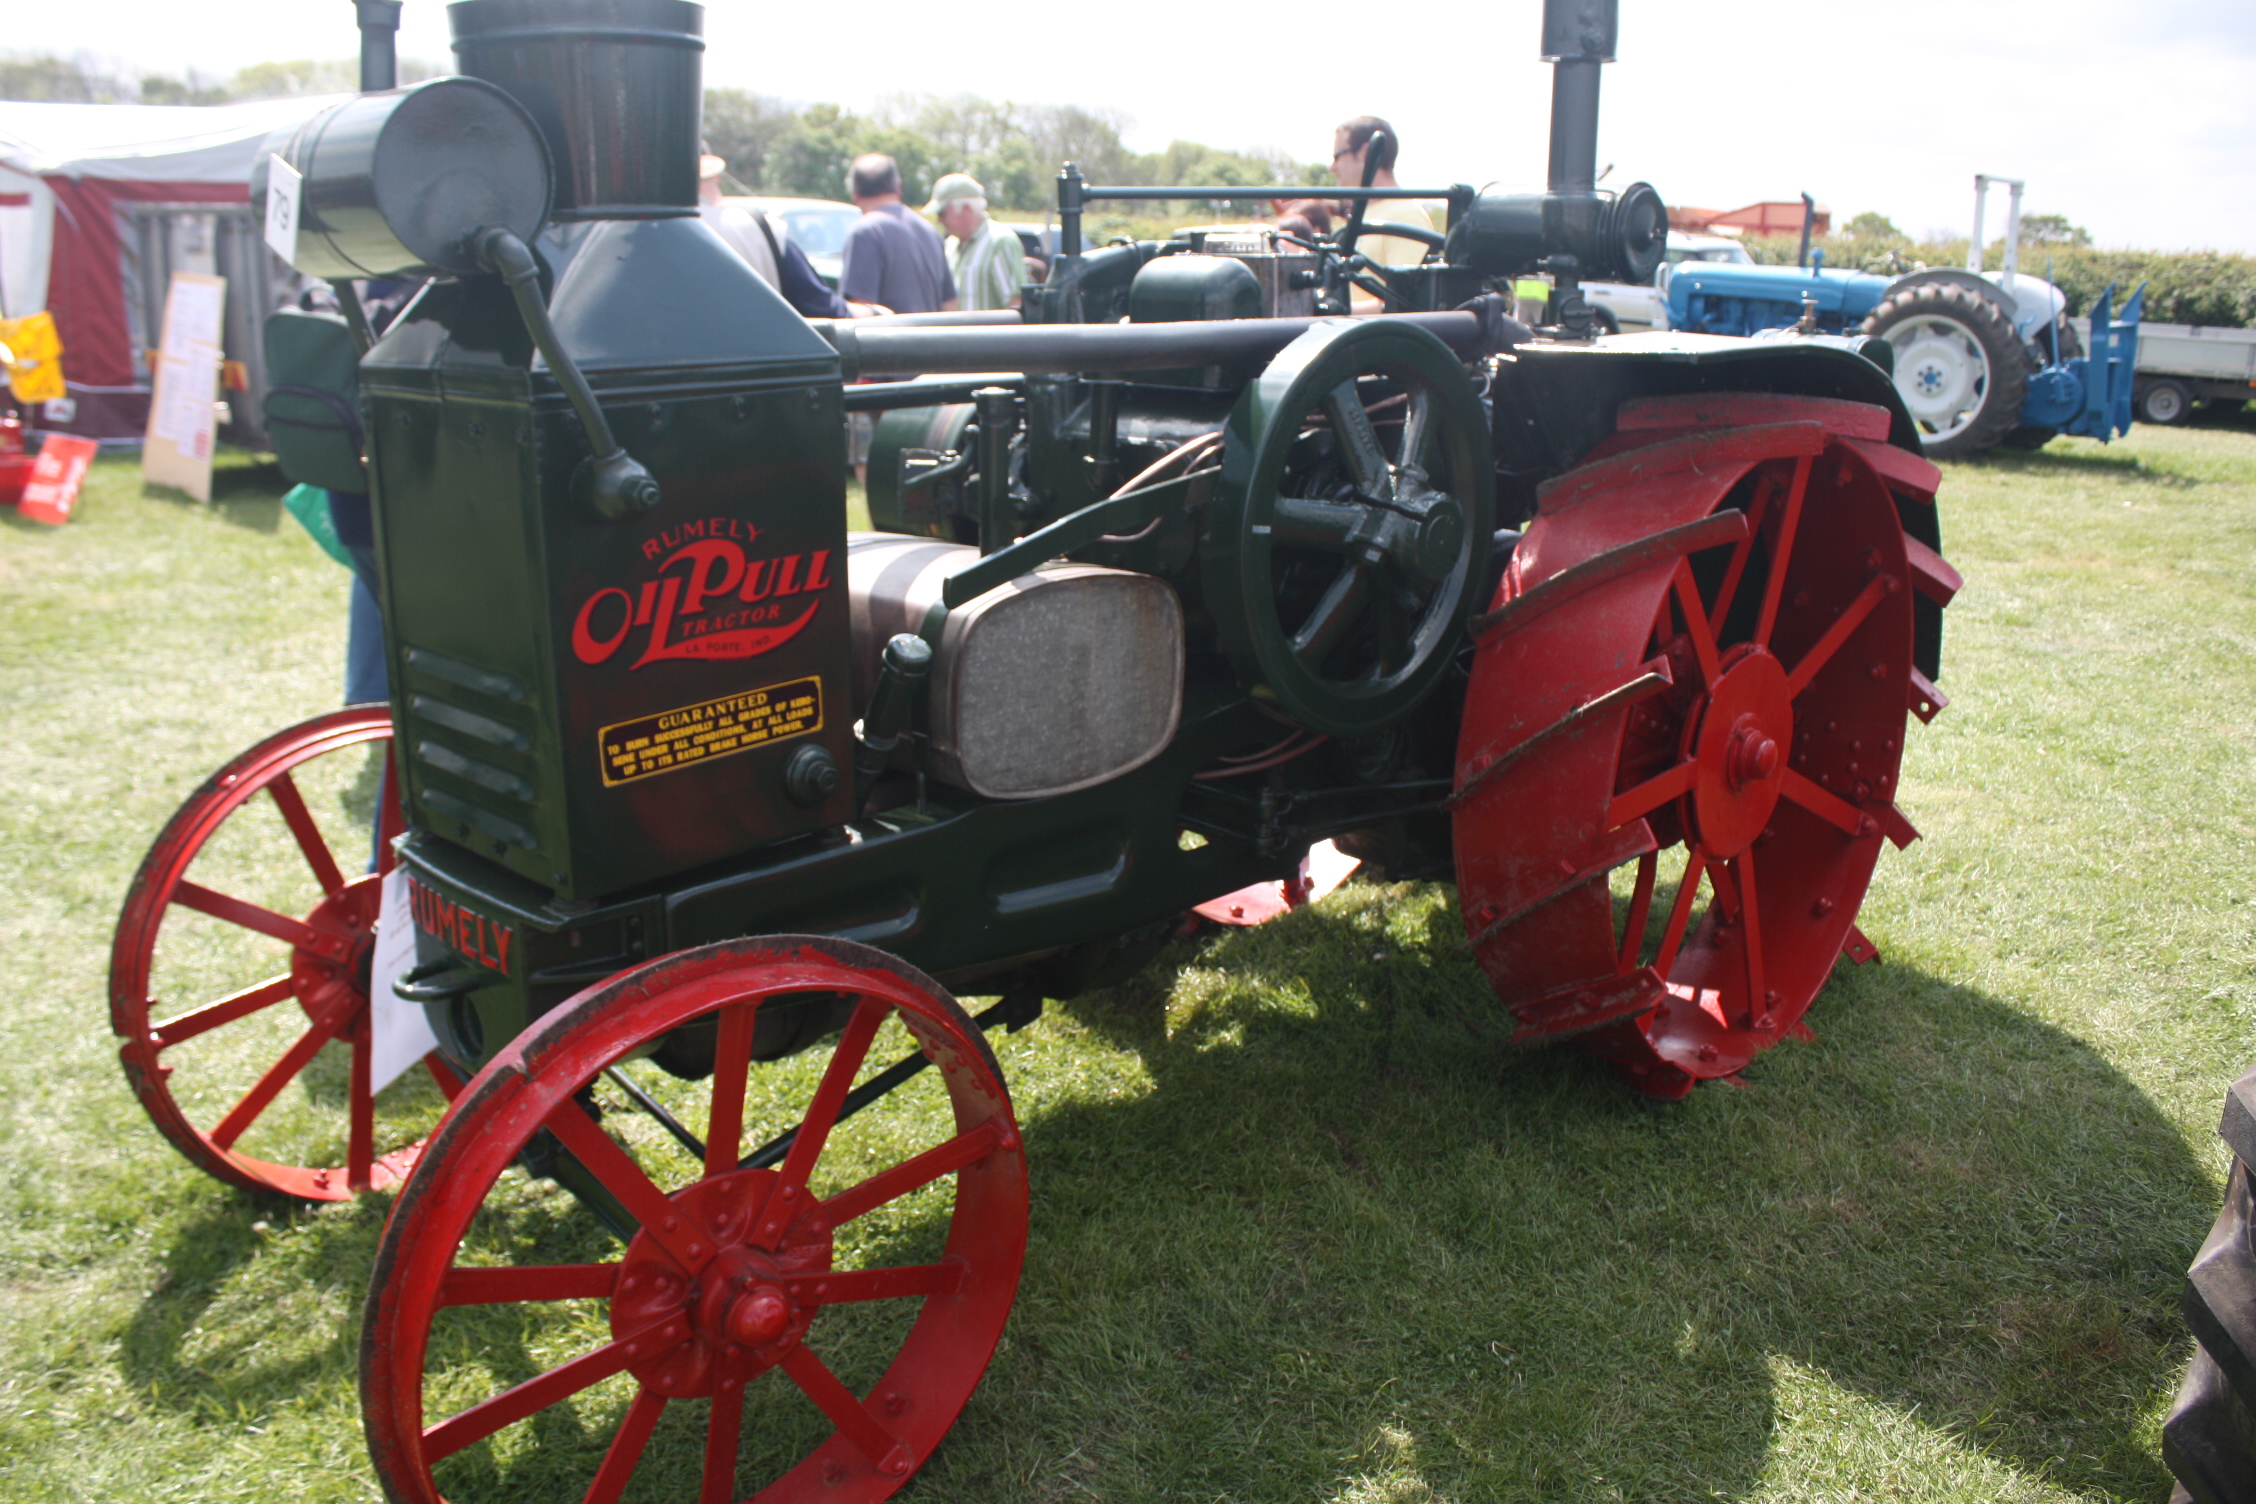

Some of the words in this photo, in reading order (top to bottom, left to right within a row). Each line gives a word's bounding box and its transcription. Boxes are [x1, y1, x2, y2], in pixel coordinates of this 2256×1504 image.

[272, 185, 290, 230] 79
[641, 518, 765, 560] RUMELY
[682, 604, 782, 637] TRACTOR
[685, 644, 699, 654] LA
[607, 744, 620, 756] TO
[654, 720, 714, 744] SUCCESSFULLY
[718, 715, 734, 727] ALL
[738, 705, 772, 722] GRADES
[775, 701, 787, 713] OF
[639, 743, 669, 760] UNDER
[673, 738, 690, 751] ALL
[752, 719, 763, 730] AT
[768, 714, 783, 726] ALL
[786, 706, 814, 721] LOADS
[658, 692, 768, 730] GUARANTEED
[623, 763, 637, 776] UP
[641, 759, 655, 771] TO
[658, 754, 673, 767] ITS
[676, 745, 706, 762] RATED
[709, 737, 738, 753] BRAKE
[741, 728, 769, 744] HORSE
[407, 876, 514, 976] RUMELY
